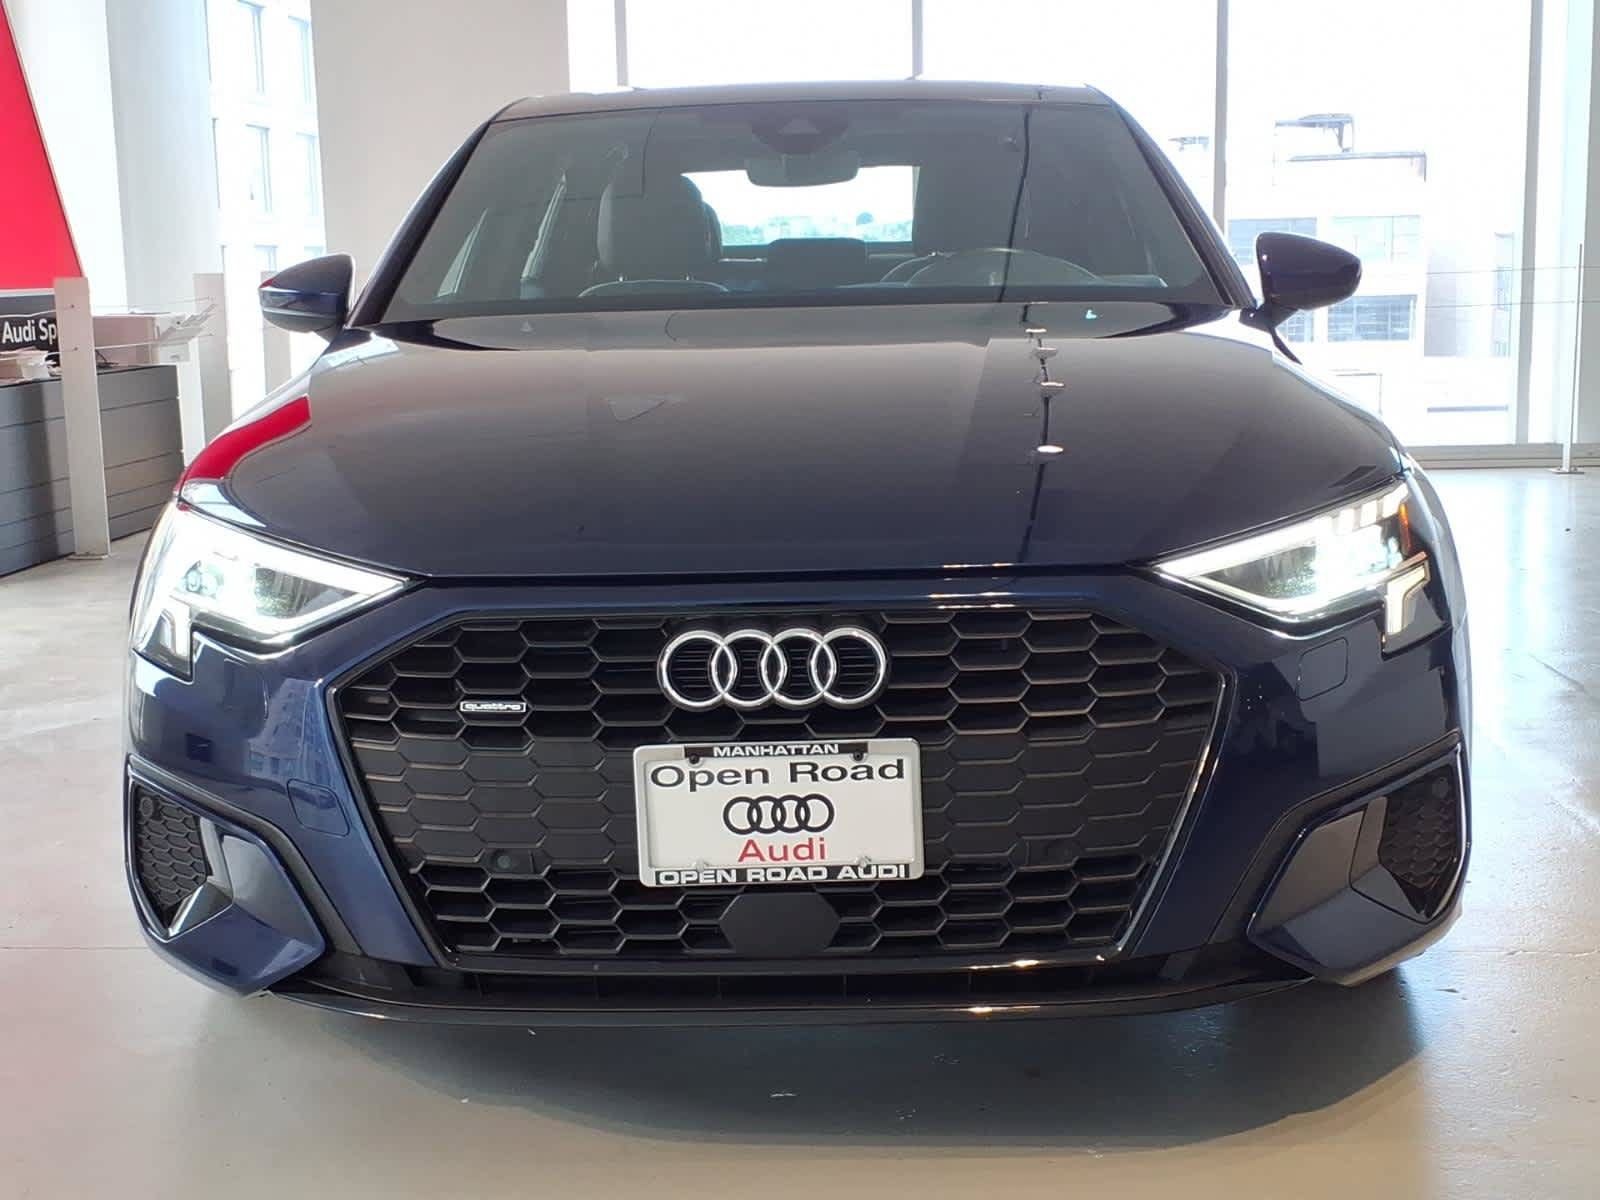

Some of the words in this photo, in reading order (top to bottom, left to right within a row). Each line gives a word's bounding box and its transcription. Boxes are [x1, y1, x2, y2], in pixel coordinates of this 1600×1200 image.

[2, 319, 36, 344] Audi
[464, 702, 521, 711] quattro
[713, 744, 839, 757] MANHATTAN
[651, 766, 770, 792] Open
[789, 759, 904, 783] Road
[738, 837, 826, 862] Audi
[659, 870, 736, 885] OPEN
[749, 867, 827, 882] ROAD
[836, 864, 906, 879] AUDI
